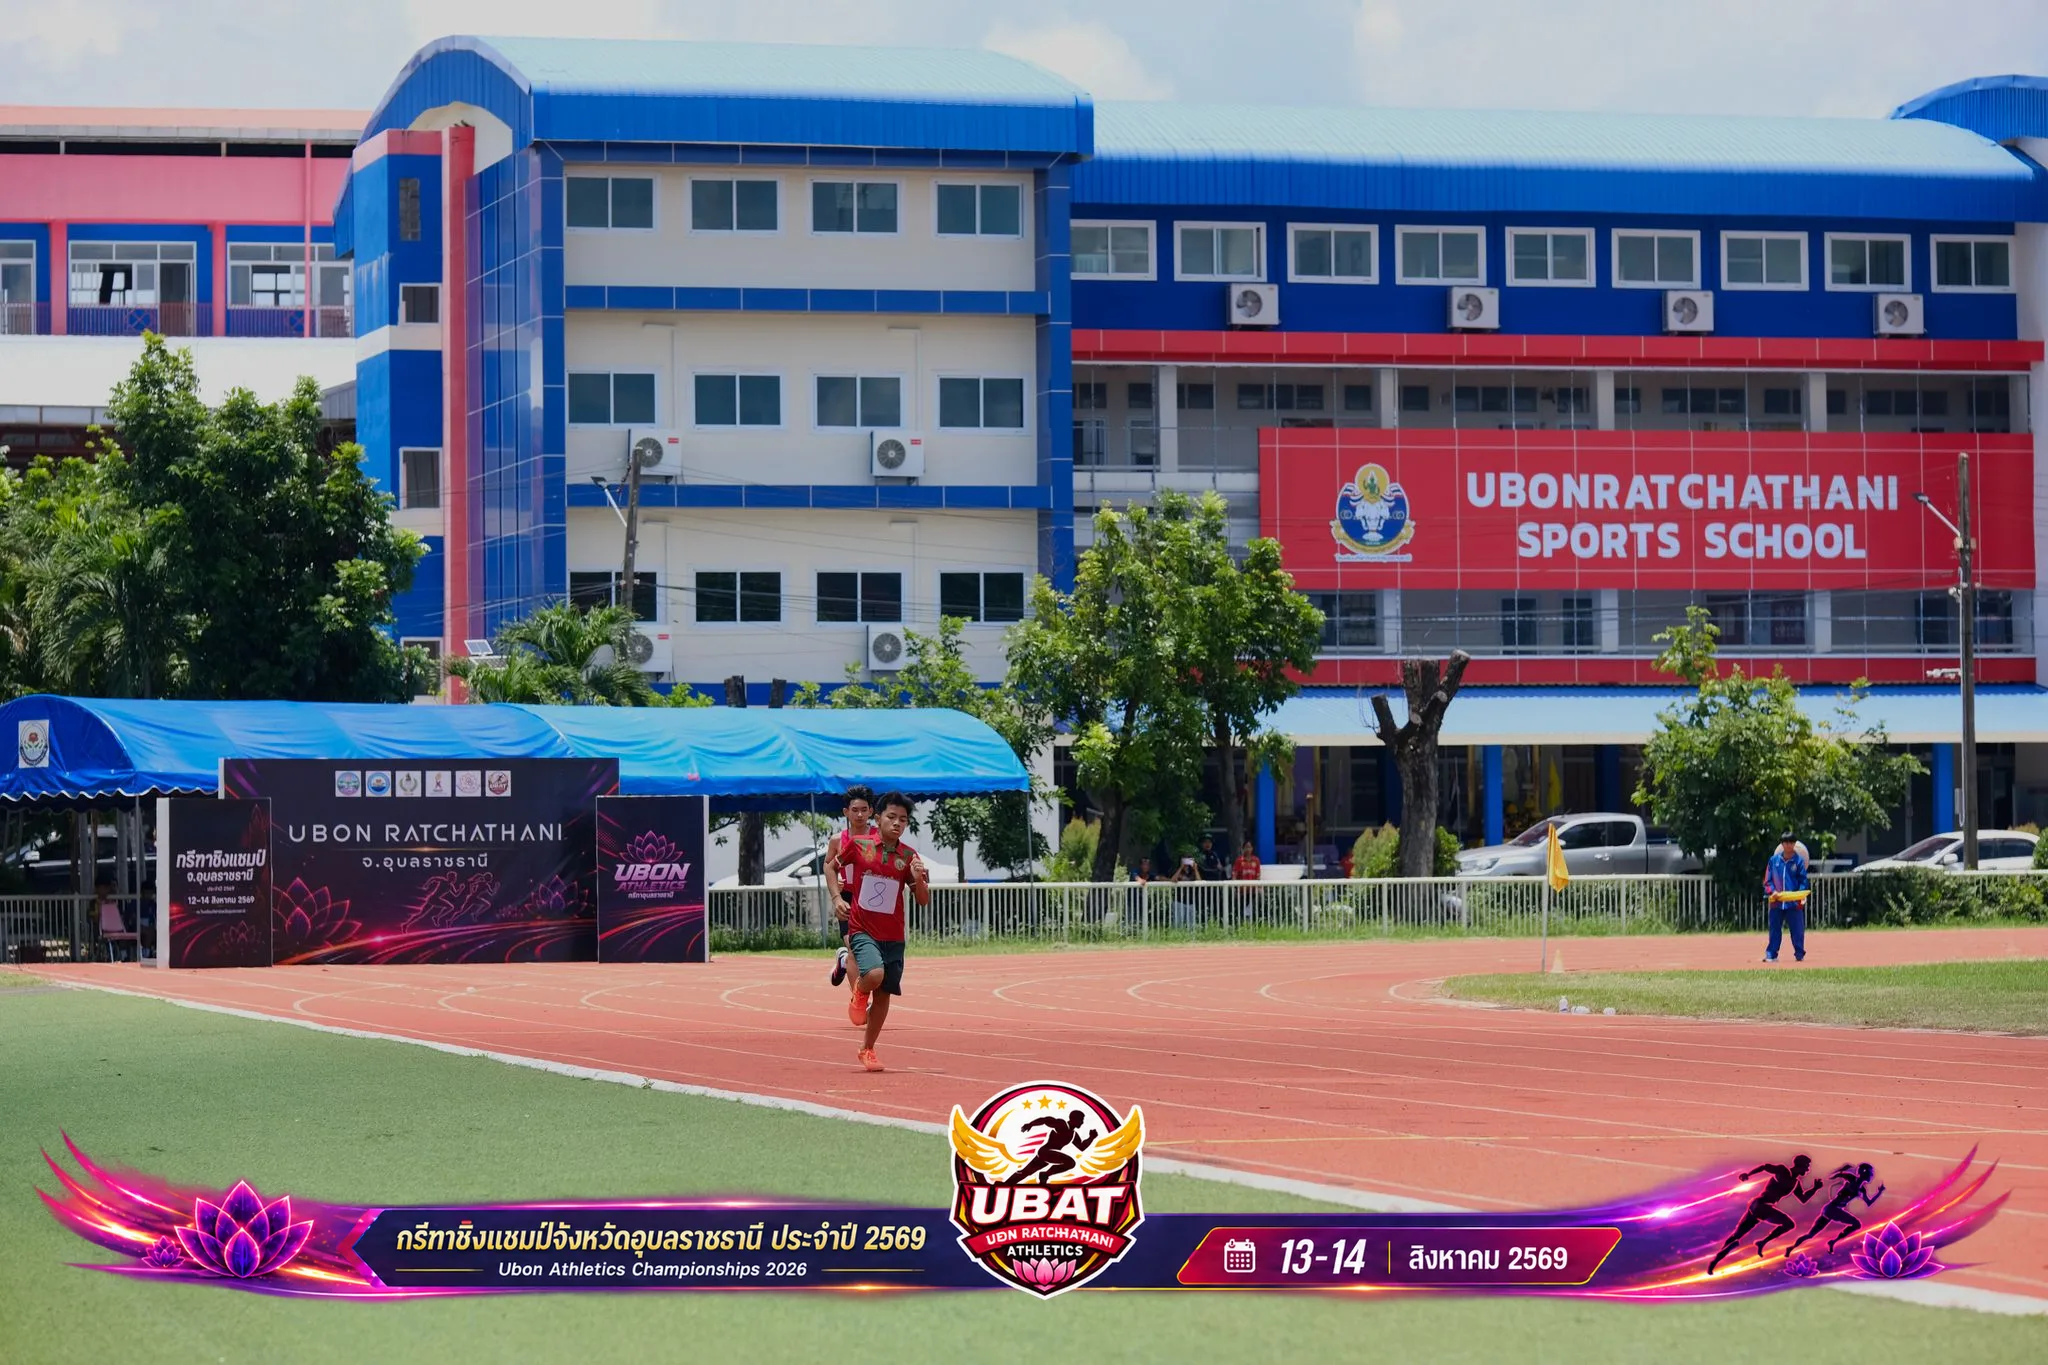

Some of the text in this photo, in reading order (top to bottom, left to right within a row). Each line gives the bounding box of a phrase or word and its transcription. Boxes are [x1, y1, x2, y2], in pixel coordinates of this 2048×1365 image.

[1467, 472, 1898, 510] UBONRATCHATHANI
[1518, 522, 1867, 559] SPORTS SCHOOL
[288, 824, 562, 843] UBON RATCHATHANI
[362, 853, 488, 872] จ.อุบลราชธานี
[614, 863, 691, 881] UBON
[187, 868, 254, 885] จ.อุบลราชธานี
[616, 881, 687, 890] ATHLETICS
[187, 896, 210, 905] 12-14
[237, 895, 255, 904] 2569
[867, 881, 886, 907] 8
